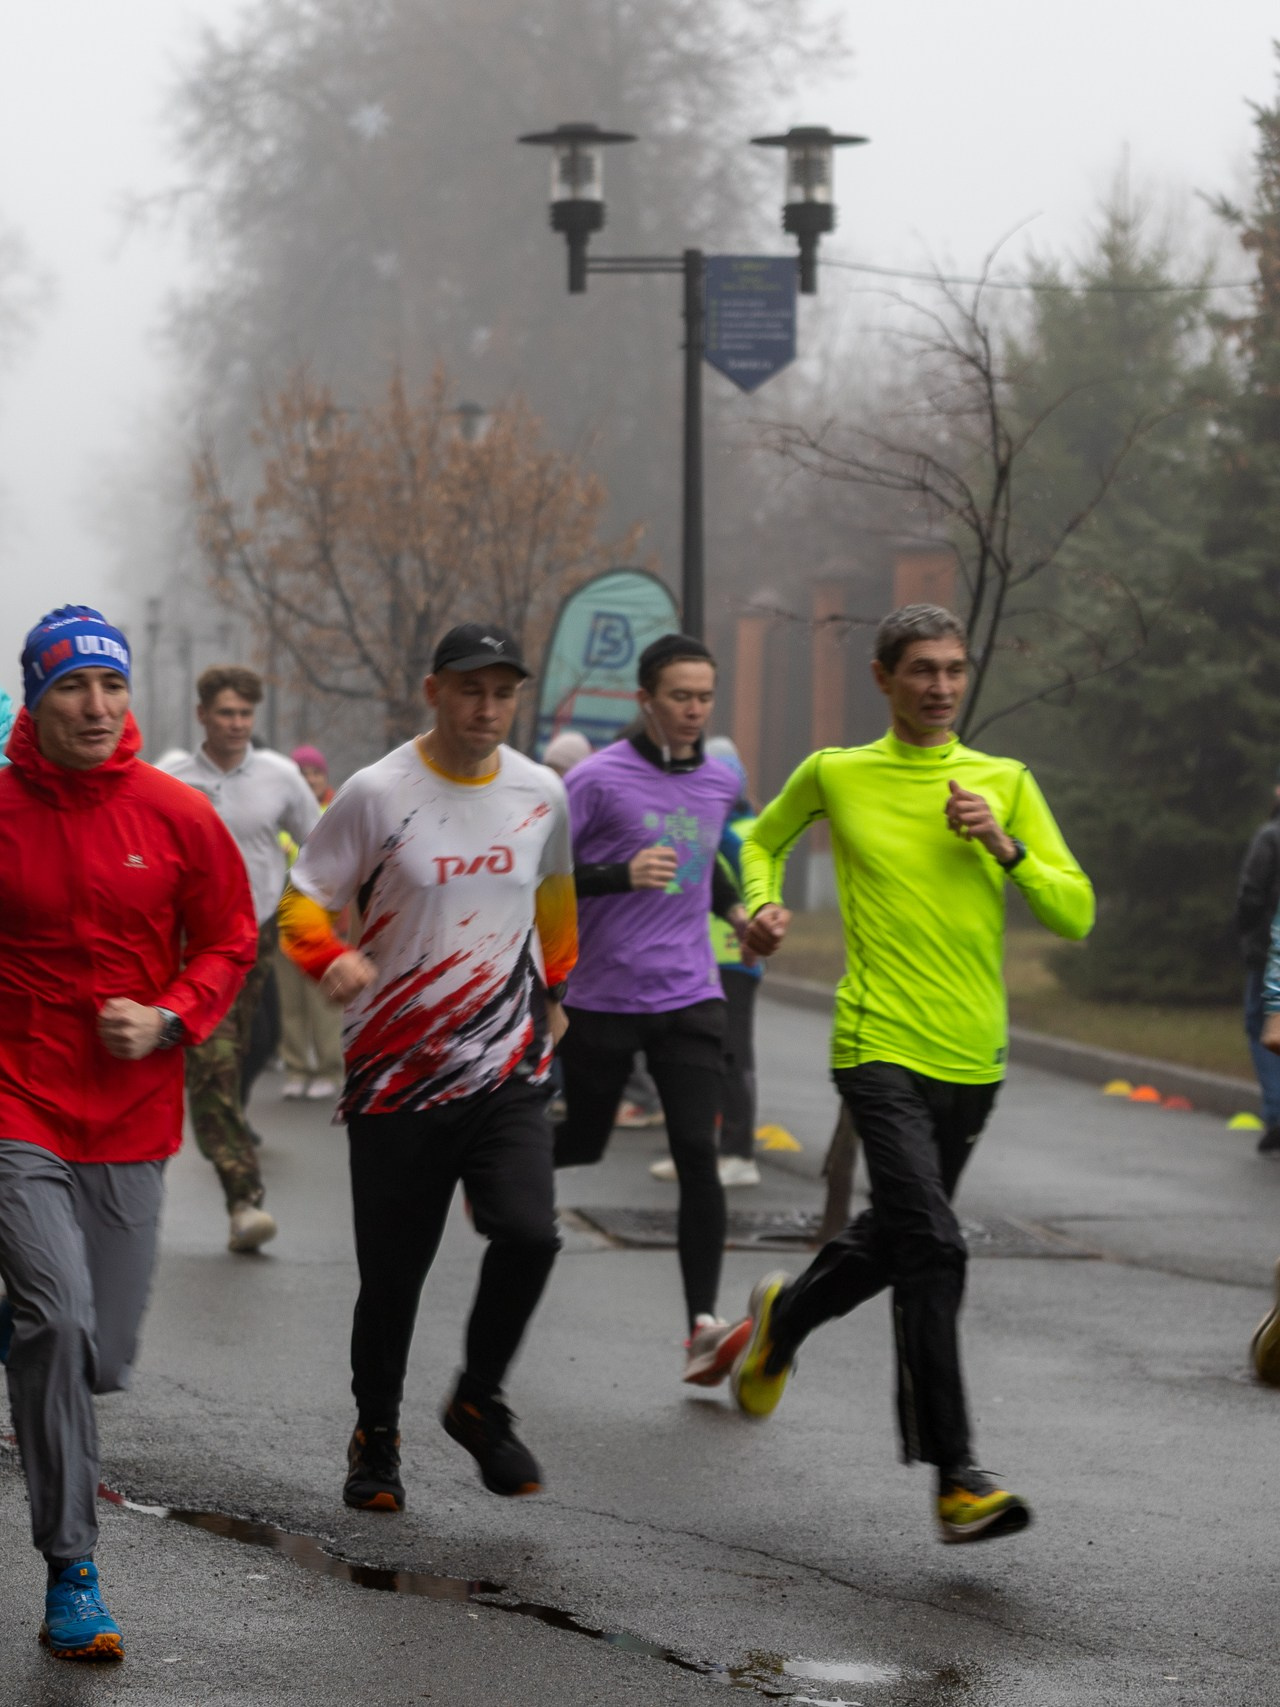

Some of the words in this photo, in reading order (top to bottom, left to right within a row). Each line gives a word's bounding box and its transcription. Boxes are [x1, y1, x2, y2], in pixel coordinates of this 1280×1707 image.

[32, 661, 45, 680] I
[41, 638, 74, 672] AM
[432, 845, 514, 886] РЖД
